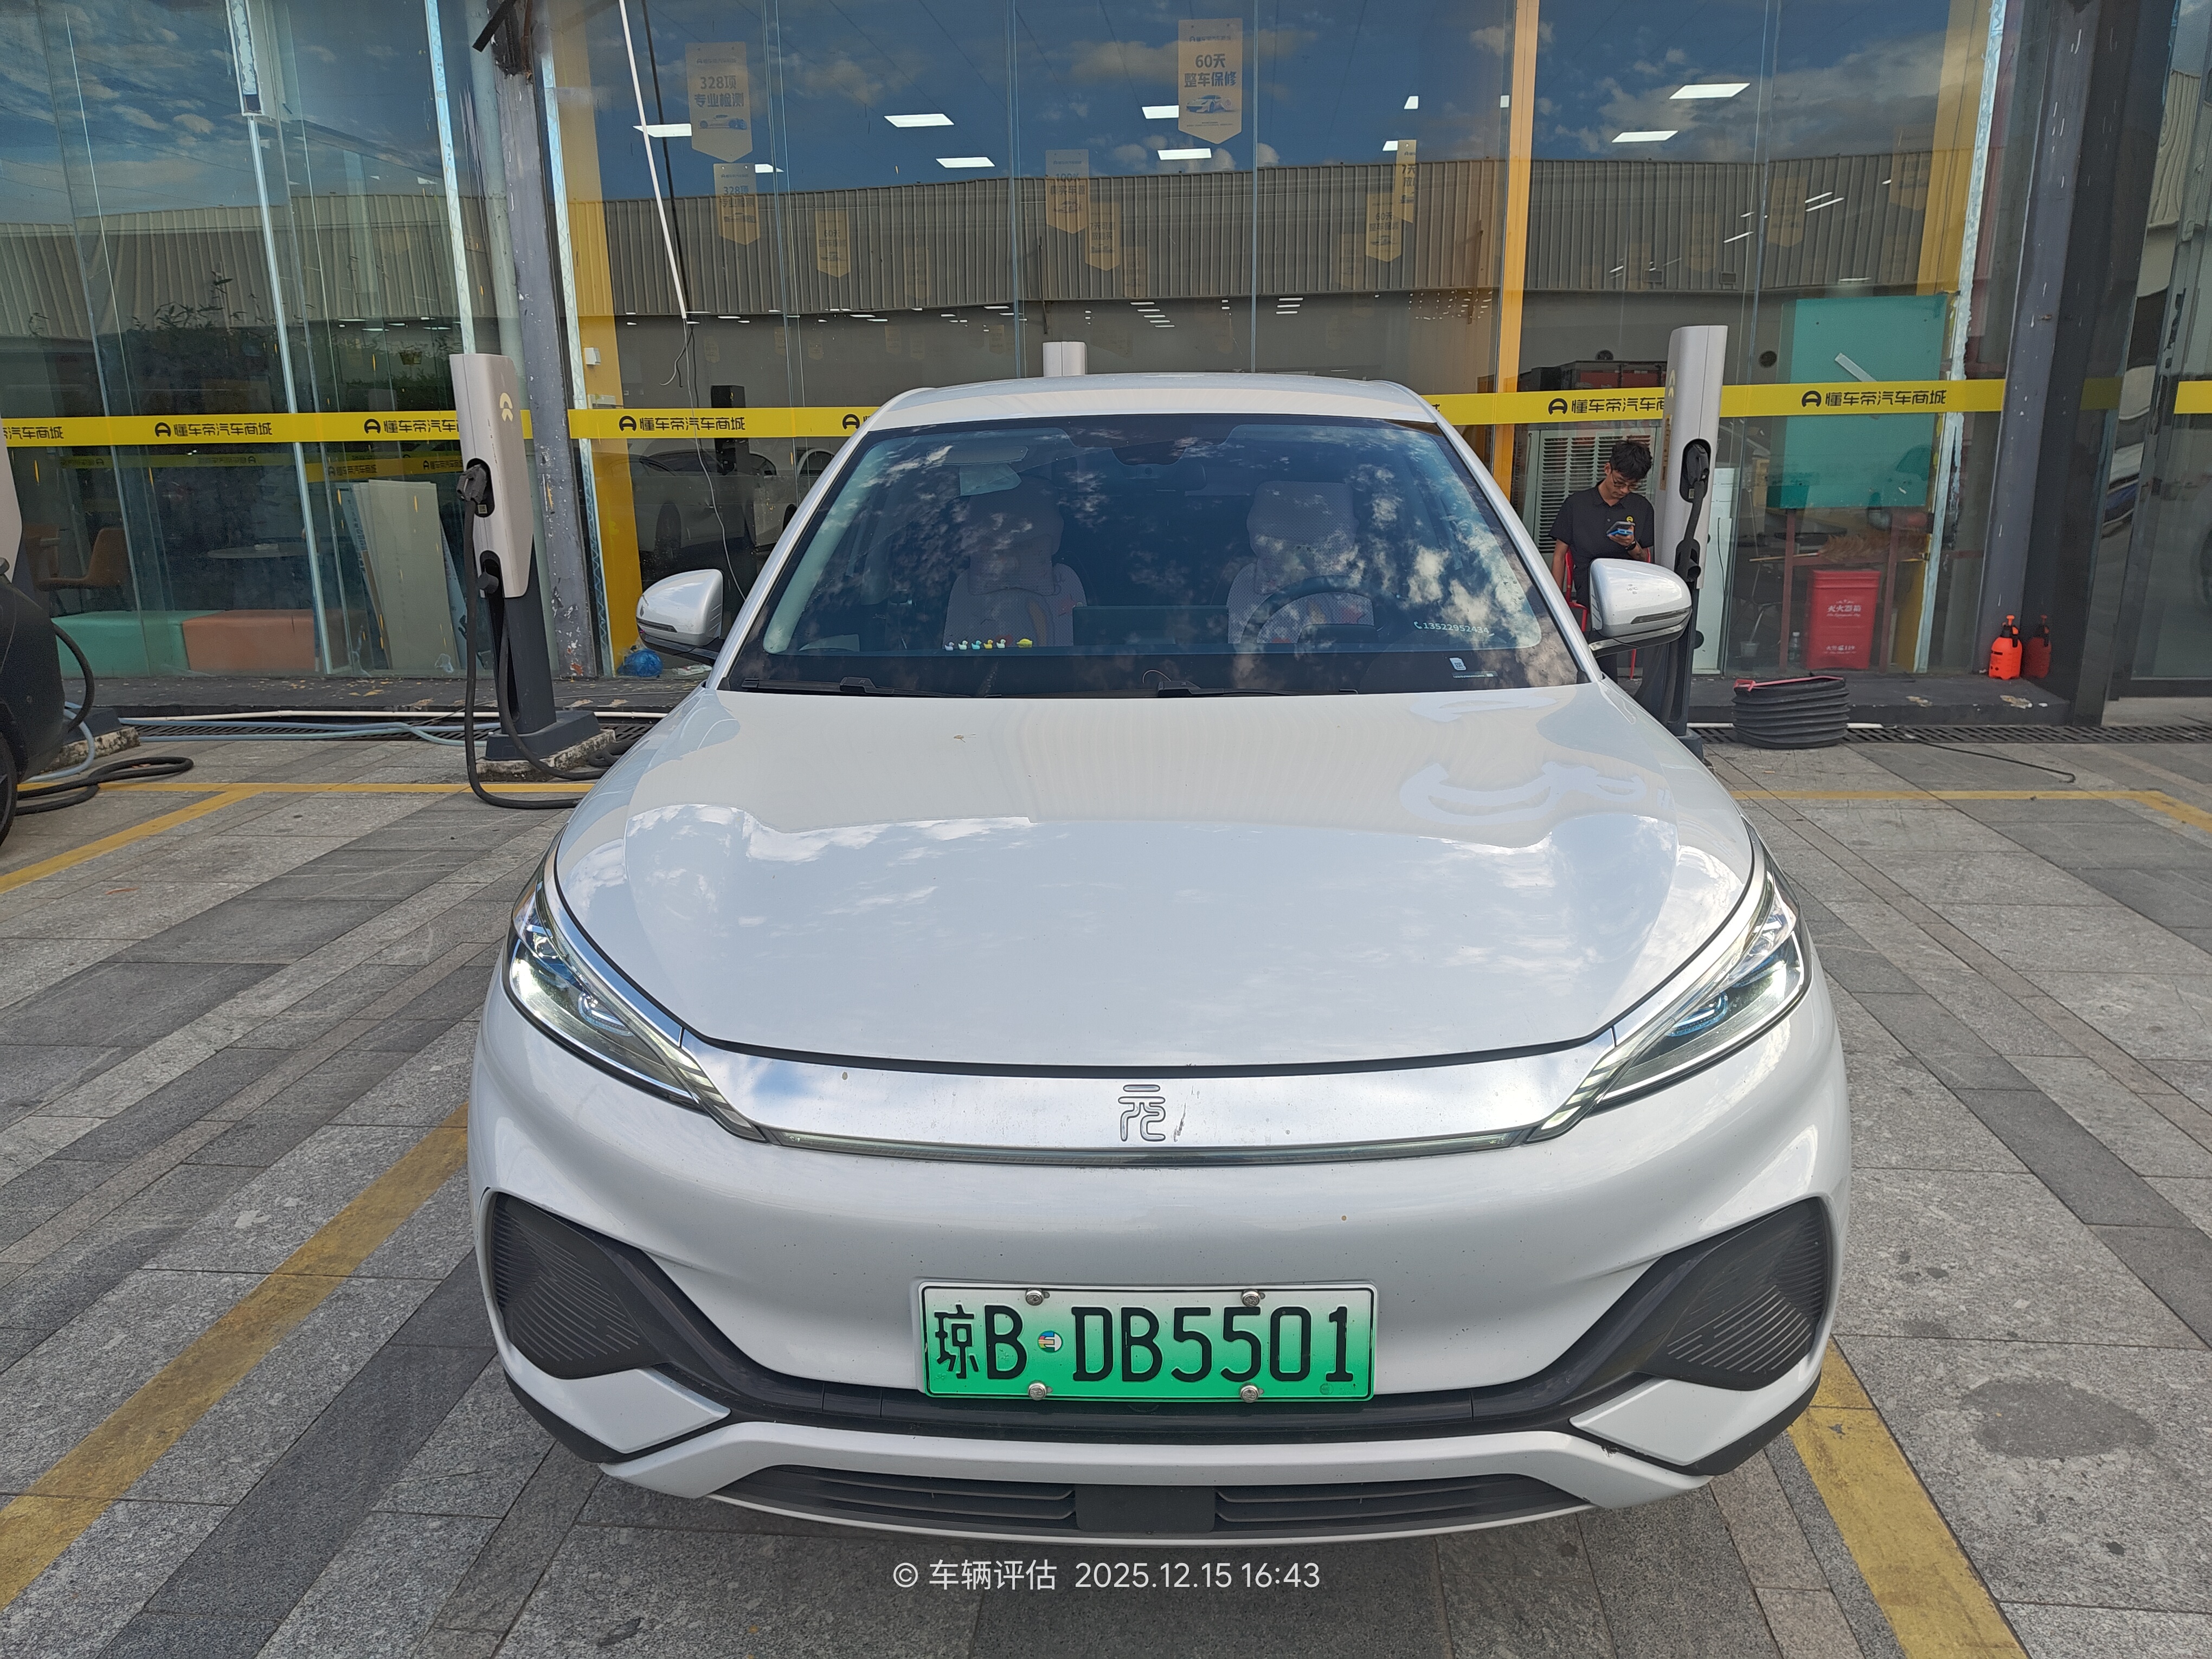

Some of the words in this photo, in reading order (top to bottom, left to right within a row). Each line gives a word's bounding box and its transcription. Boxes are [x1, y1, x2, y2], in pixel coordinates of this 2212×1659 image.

[1195, 53, 1226, 68] 60天
[700, 75, 737, 89] 328项
[1184, 71, 1237, 88] 整车保修
[695, 93, 744, 108] 专业检测
[1825, 390, 1947, 407] 懂车帝汽车商城
[173, 422, 273, 437] 懂车帝汽车商城
[383, 419, 459, 433] 懂车帝汽车
[639, 416, 746, 431] 懂车帝汽车商城
[1423, 622, 1489, 634] 13522952434
[934, 1304, 1028, 1380] 琼B
[1071, 1306, 1354, 1382] DB5501
